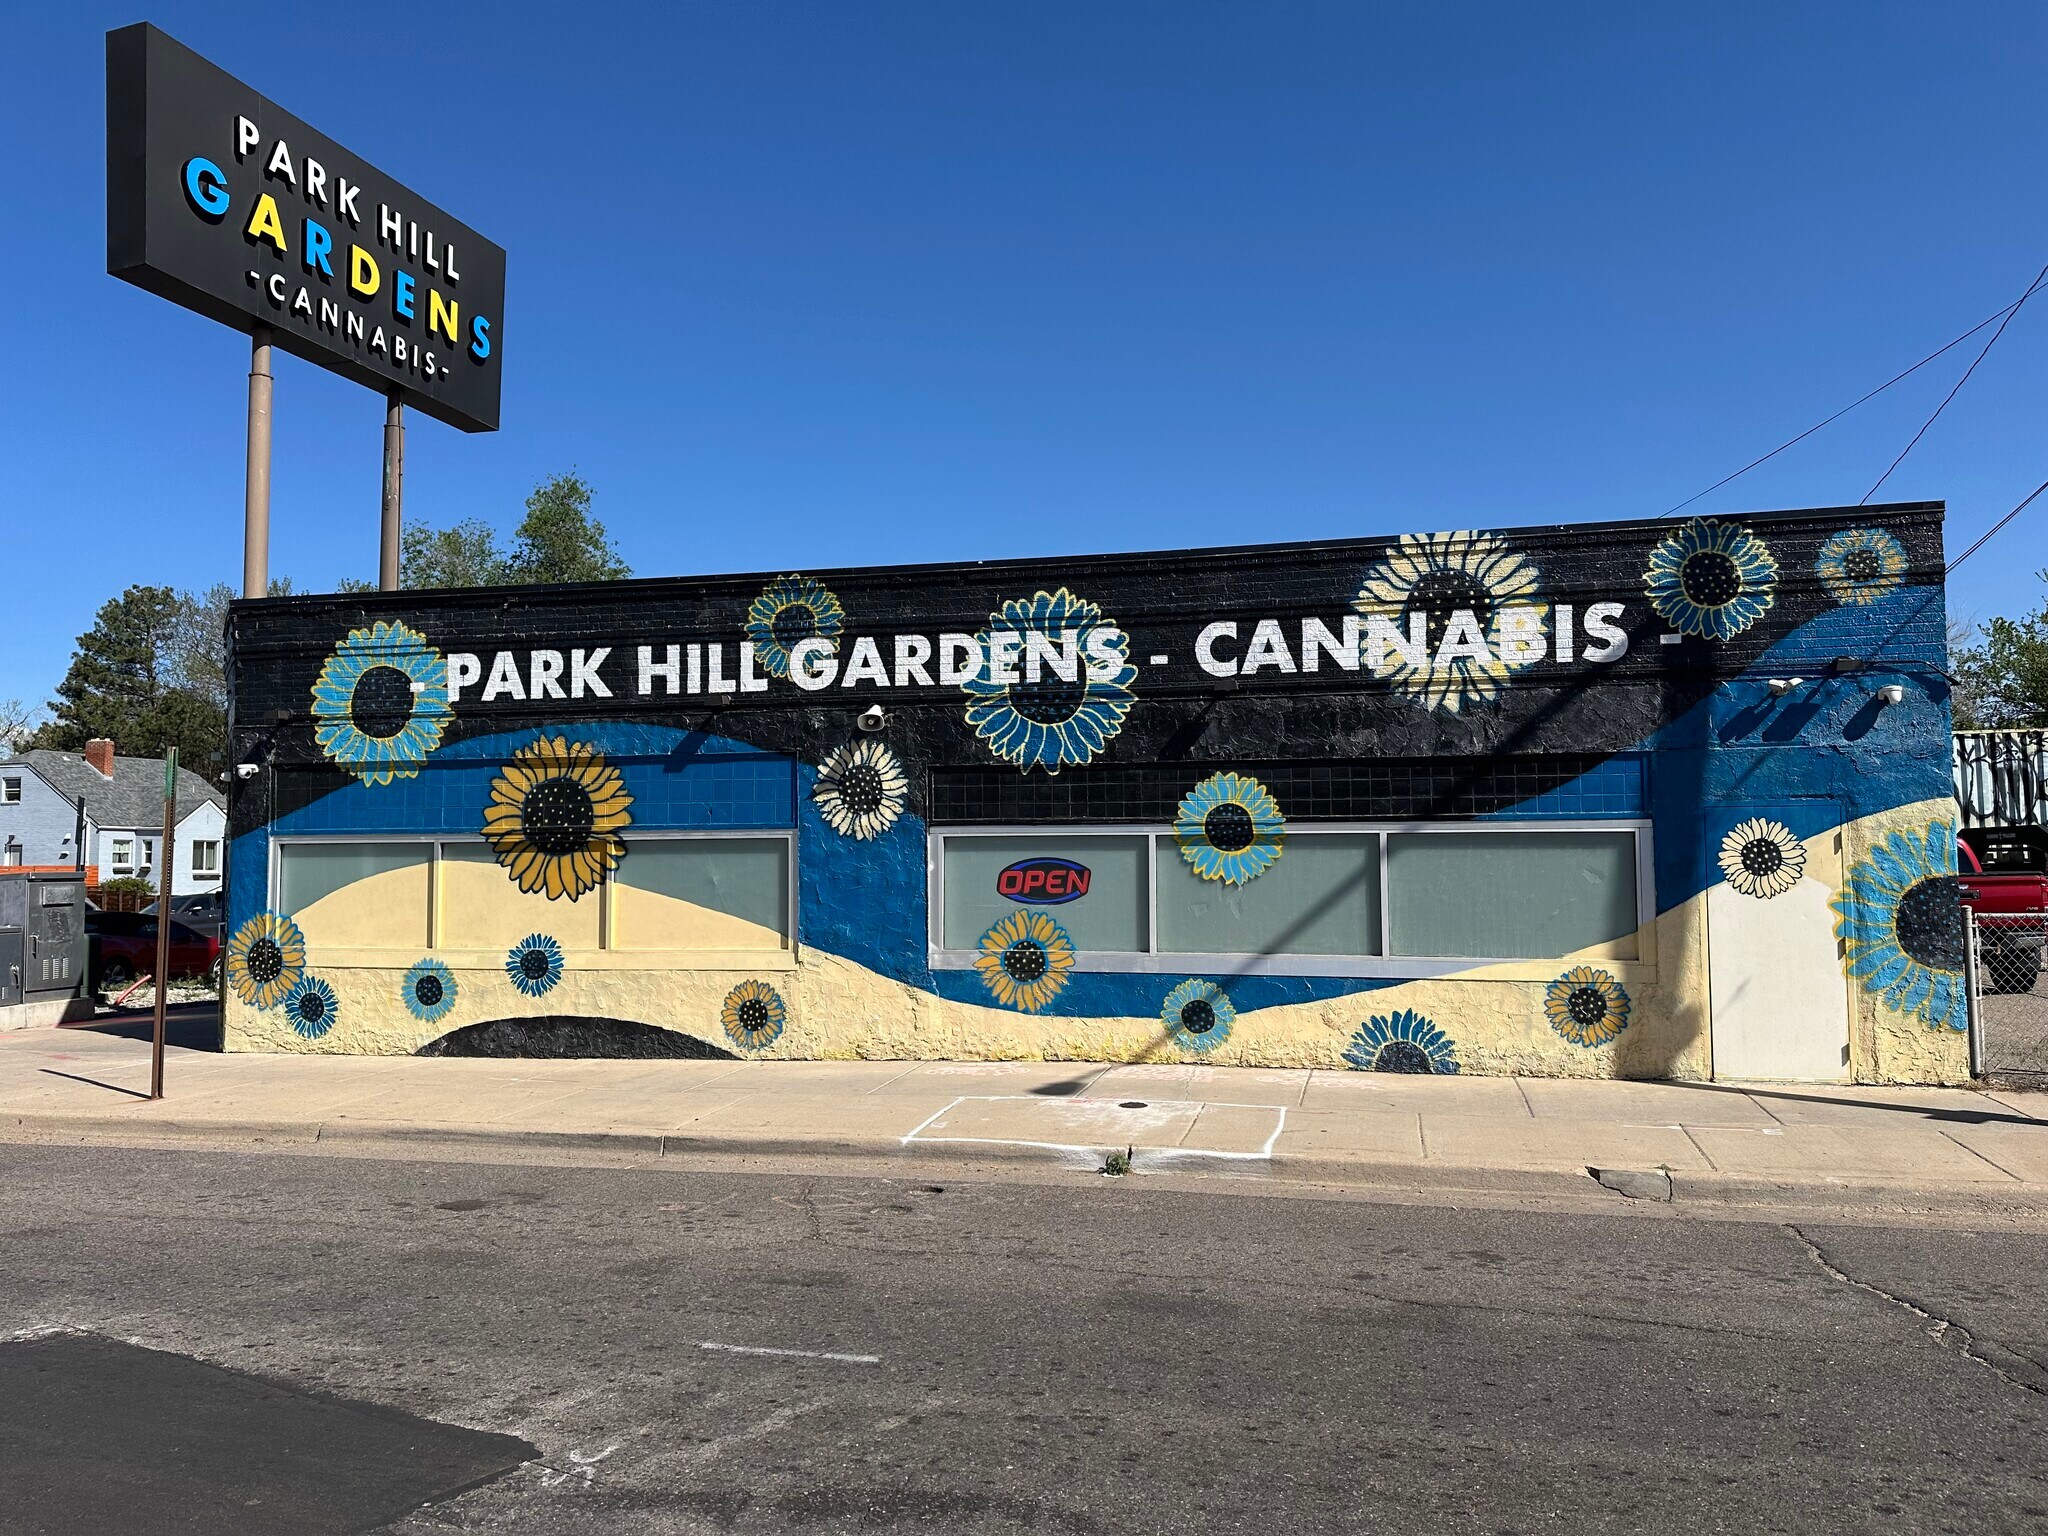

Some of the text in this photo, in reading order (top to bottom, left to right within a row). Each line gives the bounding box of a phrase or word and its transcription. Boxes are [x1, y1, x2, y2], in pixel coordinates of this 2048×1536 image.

[186, 157, 491, 359] GARDENS
[238, 115, 460, 281] PARK HILL
[446, 647, 613, 702] PARK
[638, 643, 769, 695] HILL
[790, 629, 1129, 691] GARDENS
[1195, 602, 1629, 678] CANNABIS
[1000, 870, 1090, 894] OPEN
